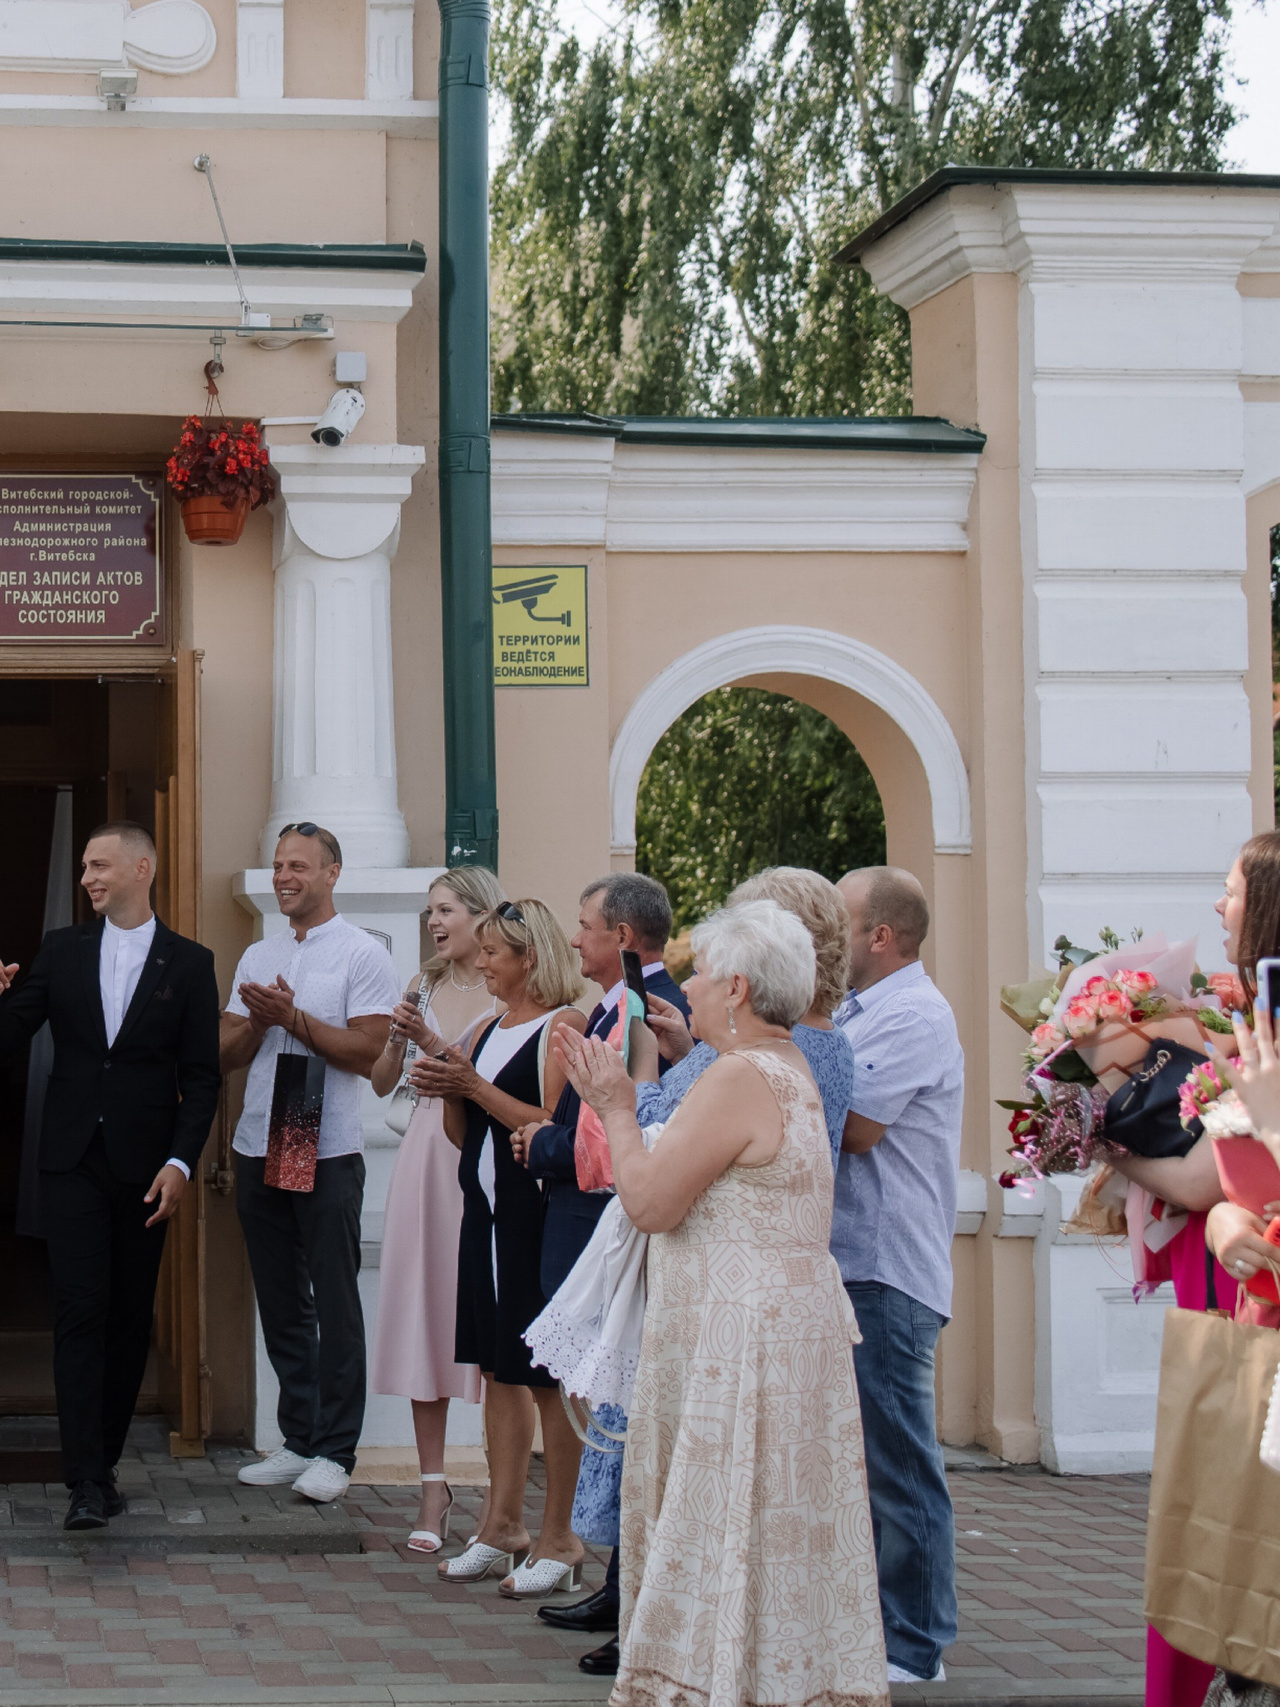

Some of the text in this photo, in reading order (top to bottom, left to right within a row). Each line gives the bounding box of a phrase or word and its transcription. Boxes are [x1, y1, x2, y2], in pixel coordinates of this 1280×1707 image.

[1, 488, 64, 500] Витебский
[95, 504, 142, 515] комитет
[13, 521, 112, 533] Администрация
[103, 536, 147, 548] района
[30, 550, 96, 562] г.Витебска
[33, 571, 91, 585] ЗАПИСИ
[96, 571, 143, 585] АКТОВ
[4, 591, 119, 606] ГРАЖДАНСКОГО
[18, 610, 106, 624] СОСТОЯНИЯ
[498, 635, 580, 646] ТЕРРИТОРИИ
[501, 649, 555, 664] ВЕДЁТСЯ
[494, 666, 585, 678] ЕОНАБЛЮДЕНИЕ
